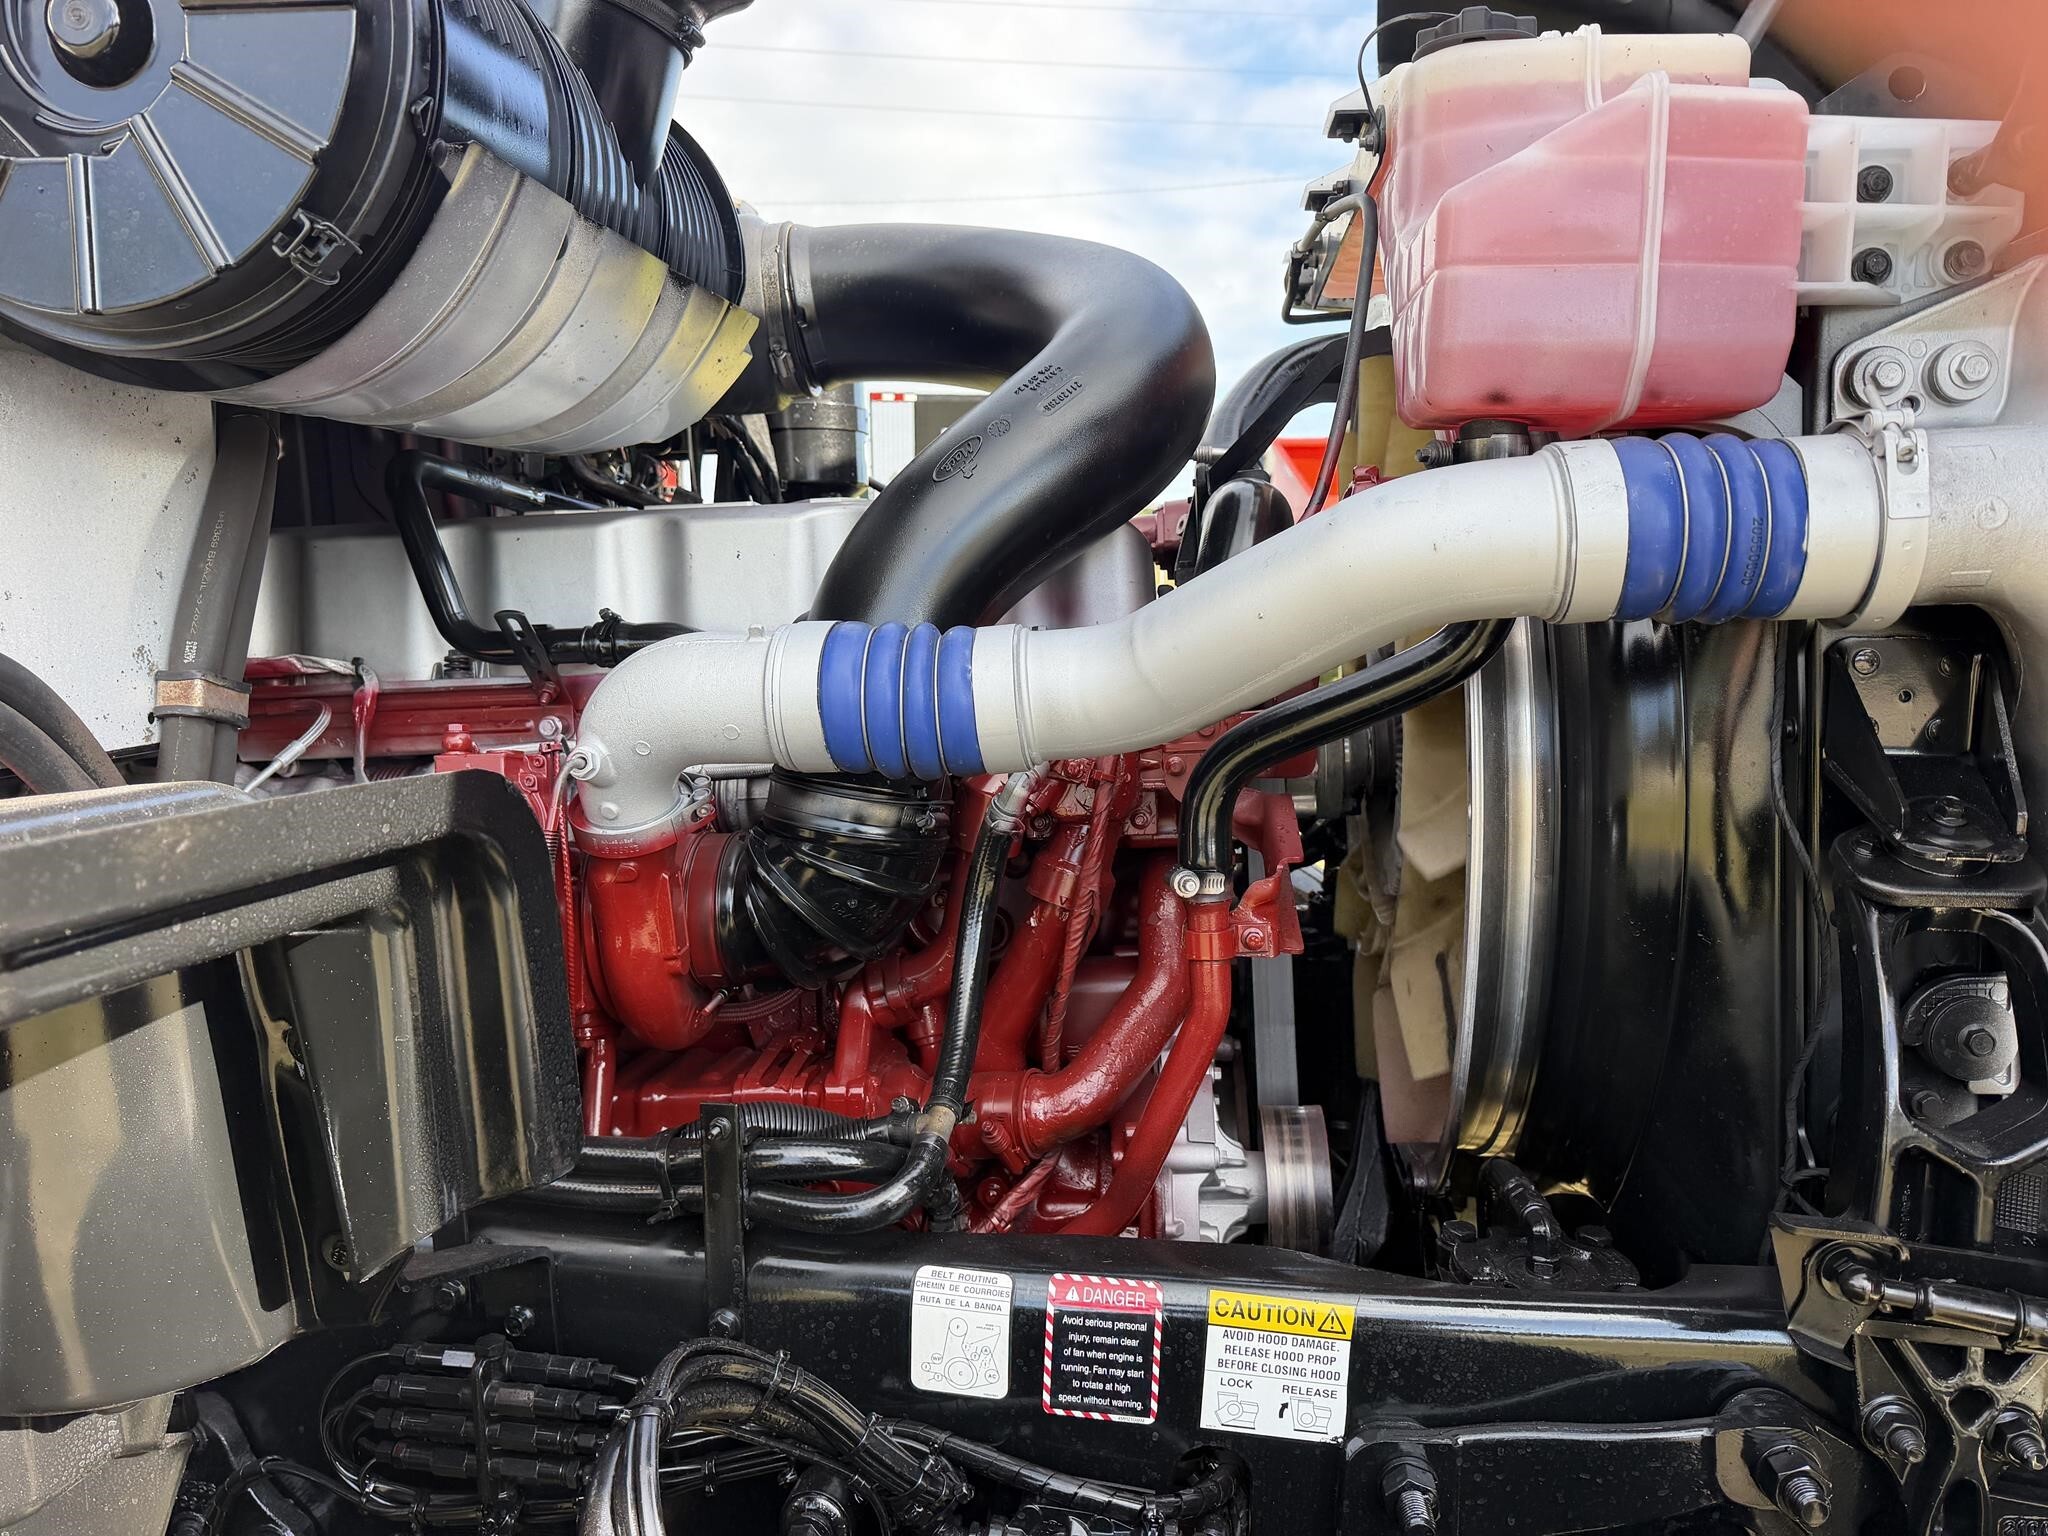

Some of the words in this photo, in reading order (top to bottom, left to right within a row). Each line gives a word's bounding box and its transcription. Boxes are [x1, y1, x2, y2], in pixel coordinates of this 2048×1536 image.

[930, 1270, 954, 1279] BELT
[958, 1273, 998, 1284] ROUTING
[916, 1280, 946, 1290] CHEMIN
[949, 1284, 960, 1292] DE
[964, 1287, 1010, 1298] COURROIES
[1083, 1286, 1146, 1308] DANGER
[920, 1295, 941, 1304] RUTA
[945, 1298, 956, 1306] DE
[960, 1300, 970, 1308] LA
[974, 1302, 1002, 1312] BANDA
[1215, 1298, 1315, 1328] CAUTION
[1062, 1314, 1084, 1326] Avoid
[1084, 1319, 1112, 1328] serious
[1114, 1321, 1147, 1332] personal
[1068, 1332, 1090, 1344] injury,
[1092, 1335, 1118, 1345] remain
[1120, 1338, 1139, 1347] clear
[1222, 1330, 1254, 1342] AVOID
[1258, 1333, 1288, 1346] HOOD
[1292, 1337, 1340, 1352] DAMAGE.
[1064, 1348, 1071, 1356] of
[1073, 1348, 1085, 1357] fan
[1086, 1350, 1107, 1359] when
[1109, 1354, 1134, 1362] engine
[1136, 1354, 1143, 1363] is
[1224, 1344, 1270, 1359] RELEASE
[1274, 1350, 1304, 1362] HOOD
[1308, 1354, 1337, 1366] PROP
[1061, 1364, 1091, 1375] running.
[1093, 1365, 1108, 1375] Fan
[1109, 1368, 1125, 1379] may
[1127, 1370, 1145, 1378] start
[1218, 1358, 1258, 1372] BEFORE
[1261, 1363, 1307, 1378] CLOSING
[1310, 1368, 1341, 1381] HOOD
[1072, 1380, 1080, 1388] to
[1082, 1381, 1104, 1390] rotate
[1105, 1383, 1113, 1391] at
[1114, 1384, 1131, 1394] high
[1220, 1377, 1253, 1389] LOCK
[1282, 1384, 1338, 1400] RELEASE
[1058, 1394, 1081, 1403] speed
[1083, 1396, 1110, 1406] without
[1112, 1399, 1144, 1410] warning.
